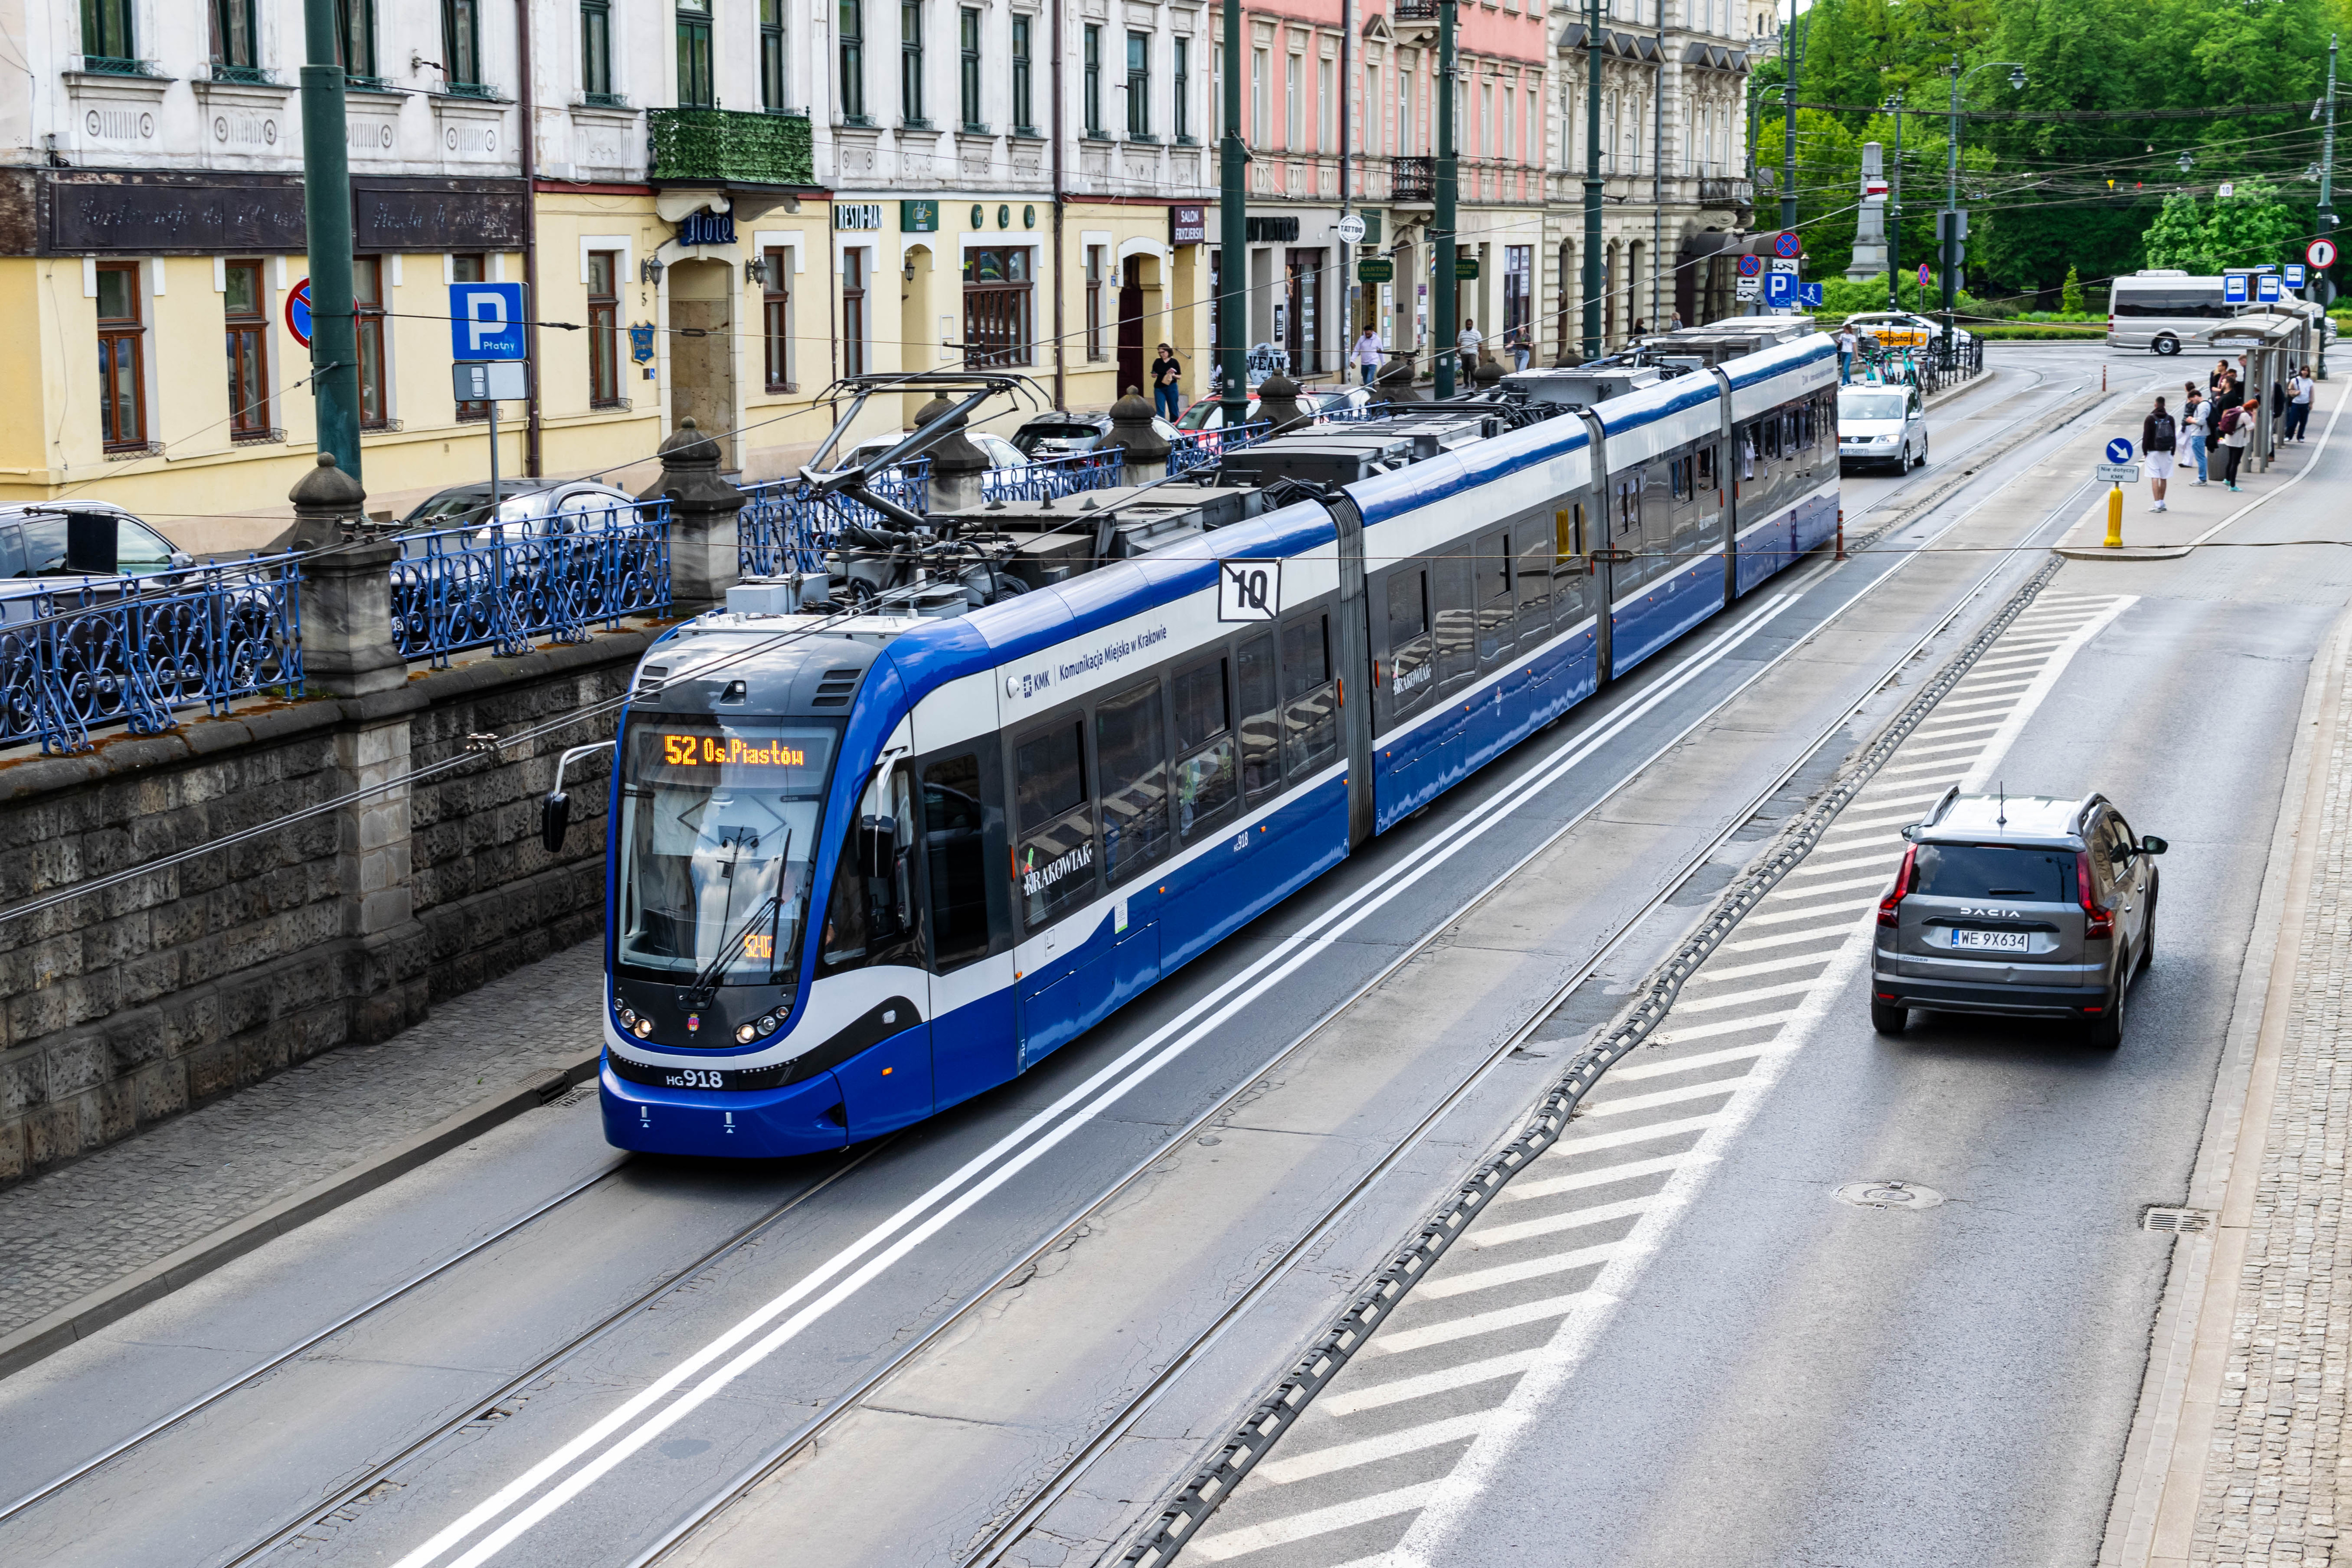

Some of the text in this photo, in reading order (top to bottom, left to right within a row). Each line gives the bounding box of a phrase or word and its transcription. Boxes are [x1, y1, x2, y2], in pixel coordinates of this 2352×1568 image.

[1181, 210, 1199, 223] SALON
[1176, 228, 1204, 240] FRYZJERSKI
[1341, 225, 1363, 233] TATTOO
[1771, 276, 1787, 297] P
[641, 292, 648, 307] 5
[467, 292, 507, 350] P
[1249, 356, 1286, 371] VEAN
[1232, 570, 1268, 609] 10
[1034, 623, 1167, 692] KMK Komunikacja Miejska w Krakowie
[1393, 663, 1430, 696] KRAKOWIAK
[664, 735, 697, 765] 52
[1025, 844, 1091, 897] KRAKOWIAK
[1960, 907, 2020, 917] DACIA
[1962, 932, 2025, 948] WE 9X634
